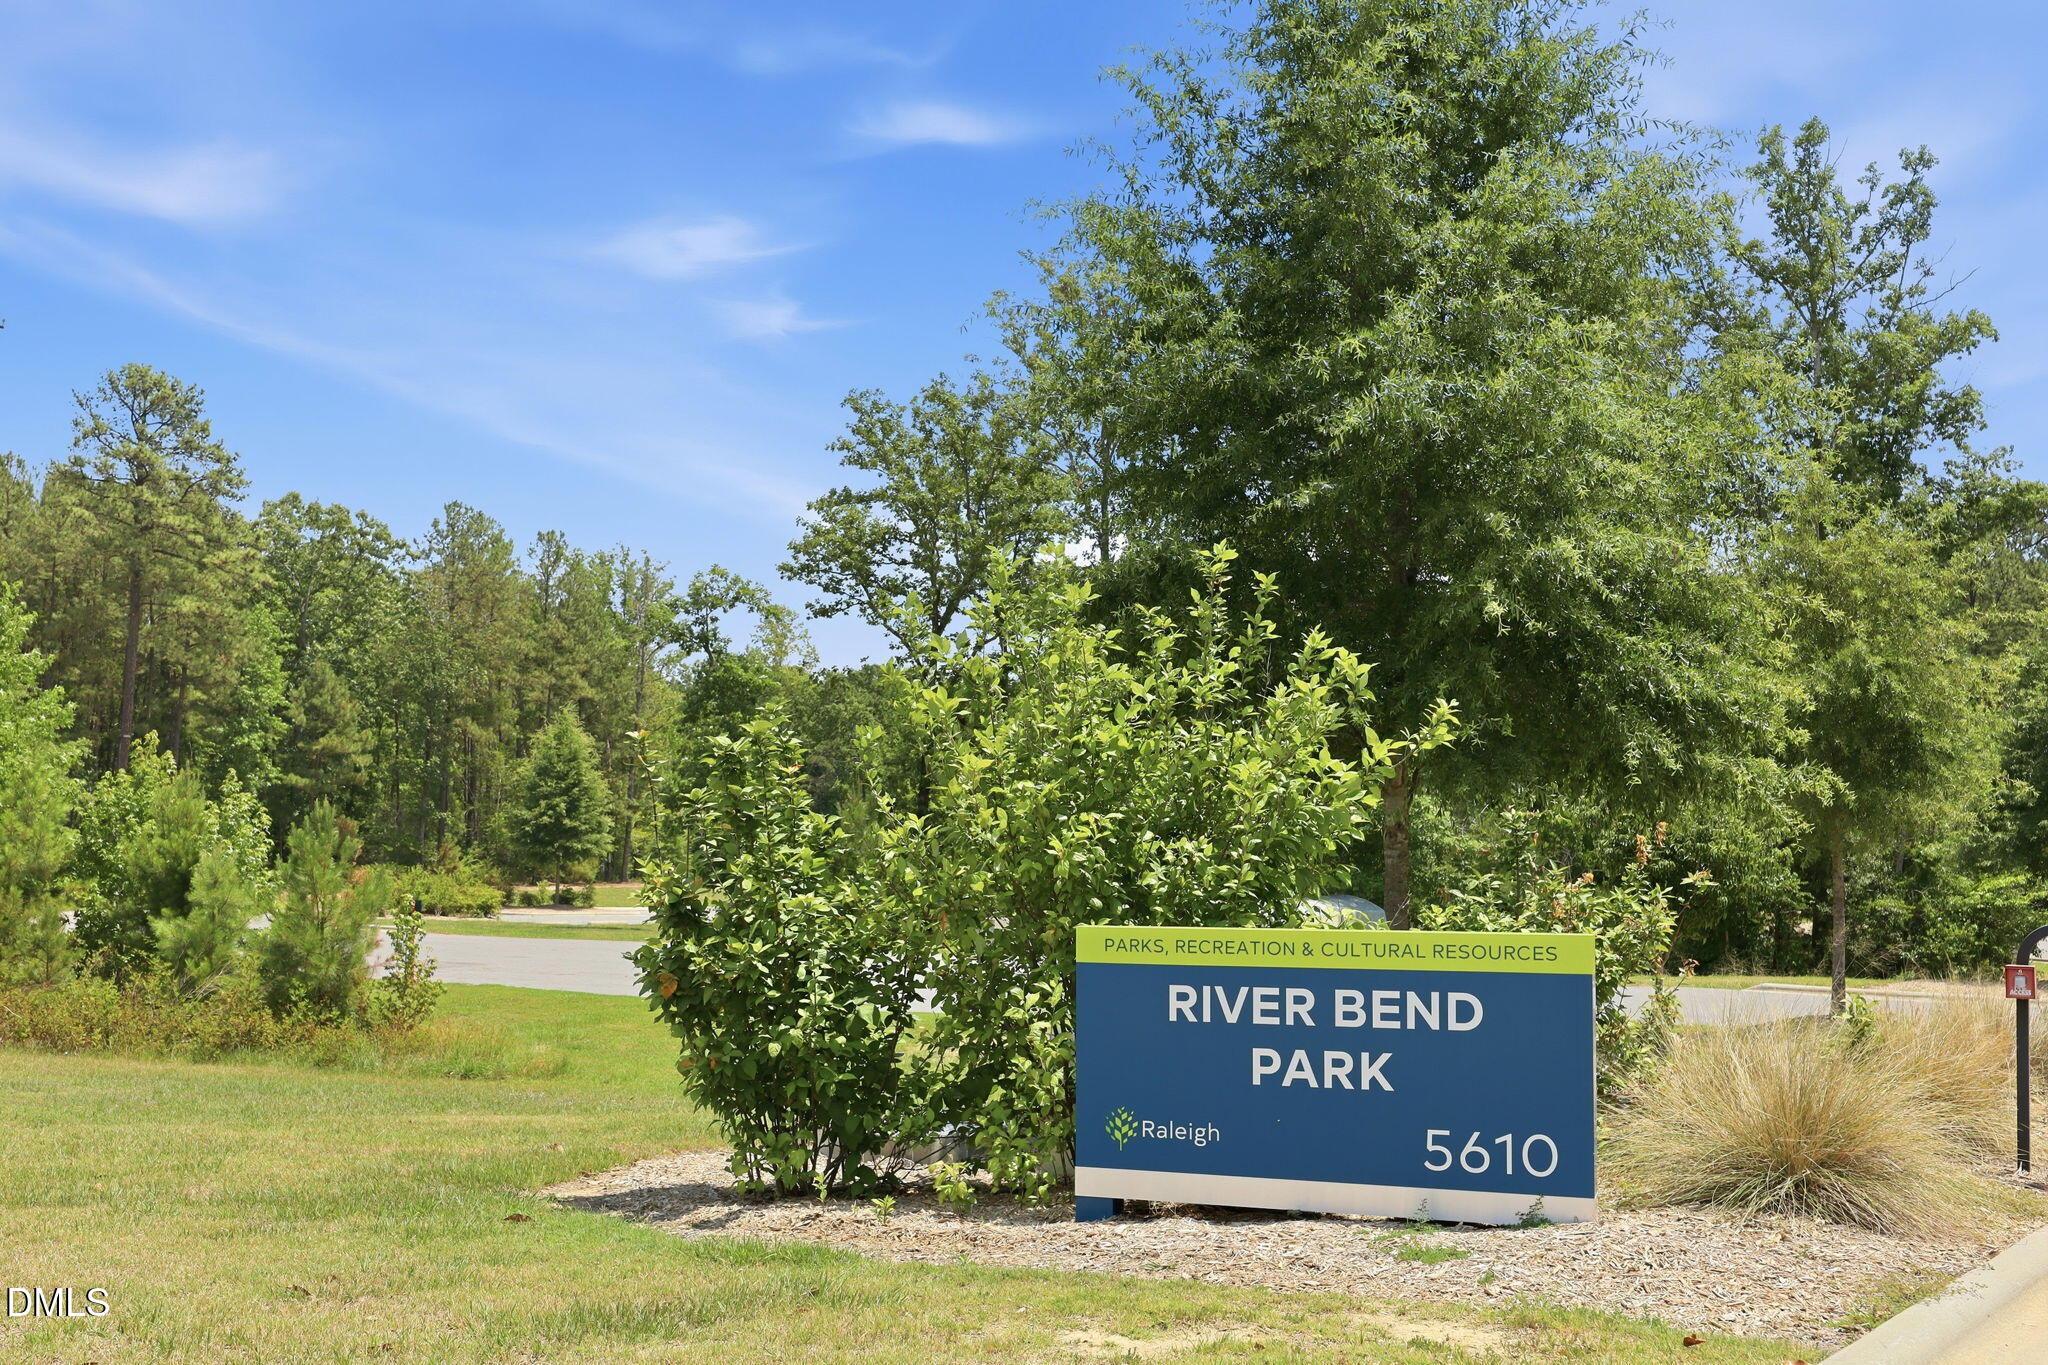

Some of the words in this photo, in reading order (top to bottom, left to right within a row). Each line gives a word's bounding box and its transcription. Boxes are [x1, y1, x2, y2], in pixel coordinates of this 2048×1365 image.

[1104, 937, 1168, 957] PARKS,
[1175, 939, 1295, 956] RECREATION
[1302, 941, 1315, 957] &
[1321, 942, 1426, 959] CULTURAL
[1432, 943, 1558, 962] RESOURCES
[1168, 984, 1316, 1027] RIVER
[1334, 988, 1484, 1032] BEND
[1252, 1047, 1395, 1092] PARK
[1142, 1120, 1220, 1147] Raleigh
[1423, 1129, 1559, 1178] 5610
